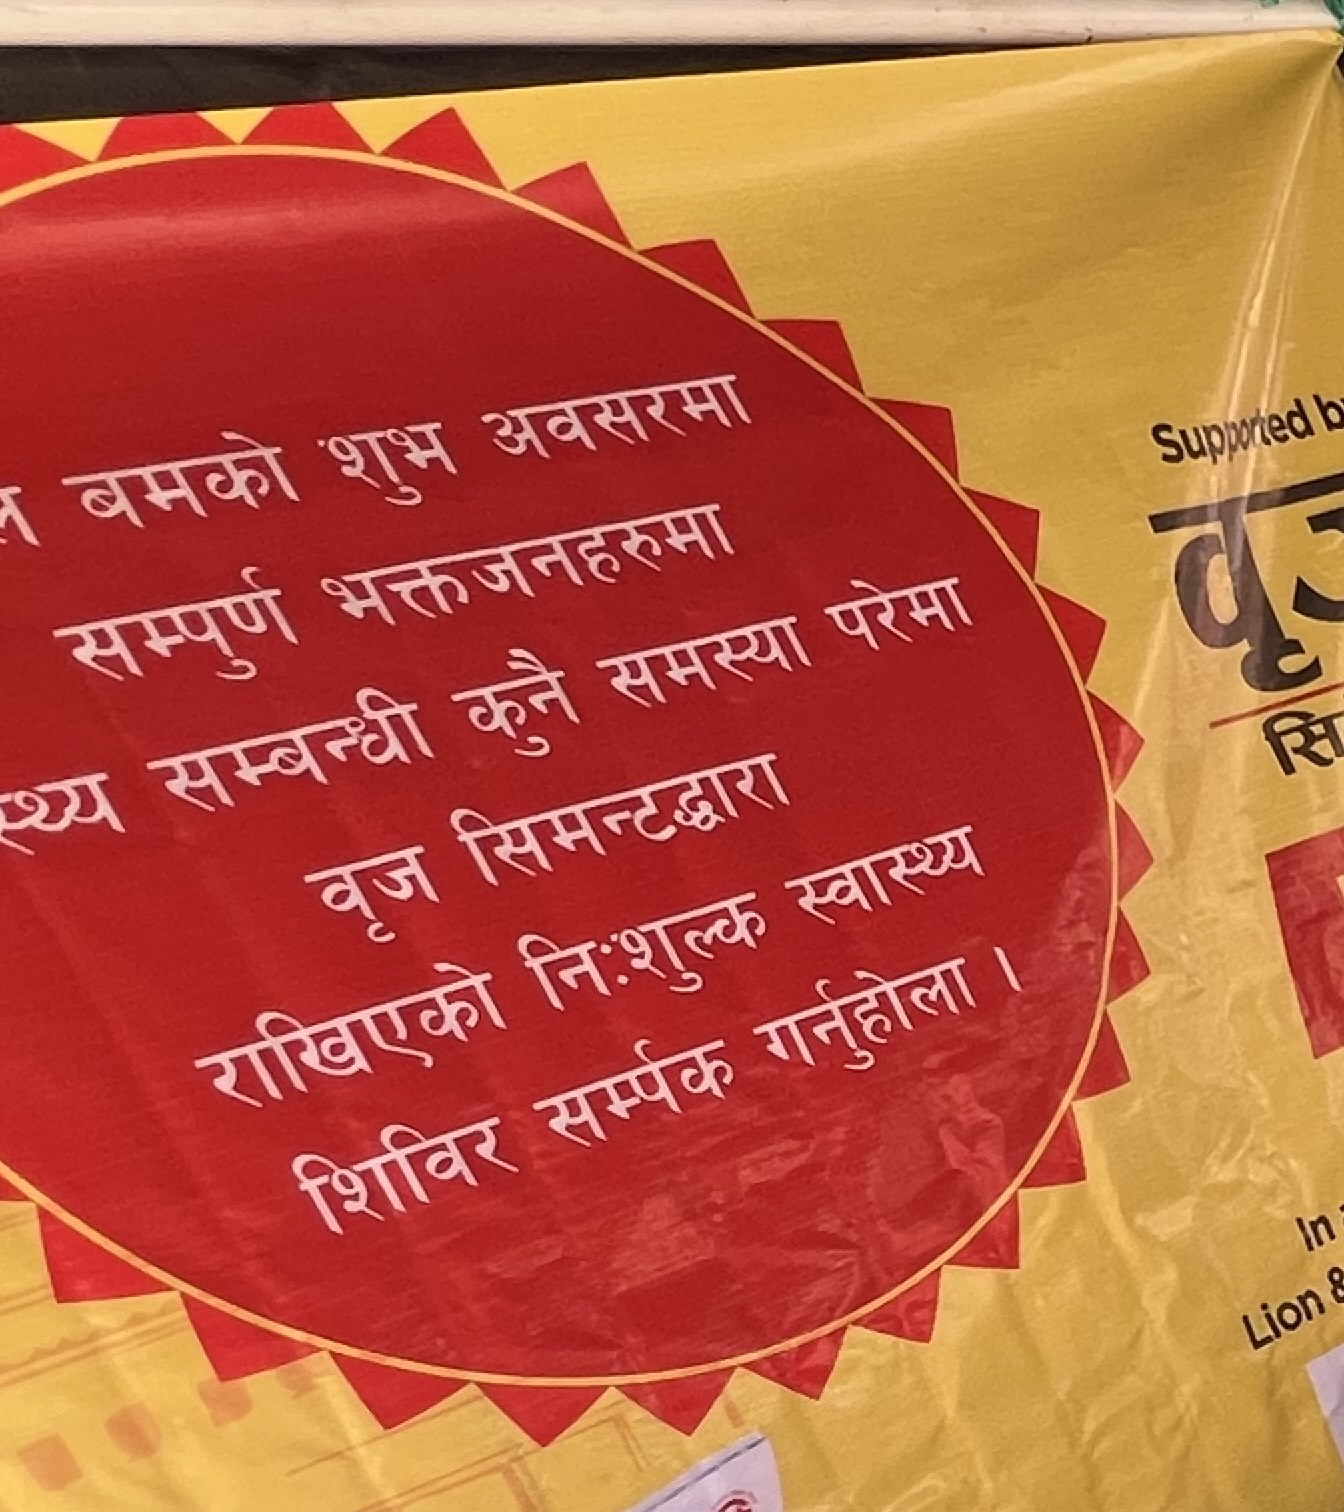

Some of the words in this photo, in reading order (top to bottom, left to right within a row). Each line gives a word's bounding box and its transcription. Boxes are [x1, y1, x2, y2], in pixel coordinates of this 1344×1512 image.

[62, 430, 300, 532] बमको
[318, 422, 457, 506] शुभ
[482, 374, 752, 458] अवसरमा
[1151, 398, 1315, 466] Supported
[53, 567, 299, 681] सम्पुर्ण
[147, 686, 434, 812] सम्बन्धी
[451, 648, 580, 757] कुनै
[596, 615, 812, 708] समस्या
[825, 577, 974, 651] परेमा
[303, 845, 441, 943] वृज
[194, 962, 508, 1108] राखिएको
[784, 825, 986, 925] स्वास्थ्य
[291, 1116, 520, 1238] शिविर
[753, 956, 976, 1071] गर्नुहोला
[1296, 1214, 1337, 1254] In
[1242, 1288, 1327, 1351] Lion
